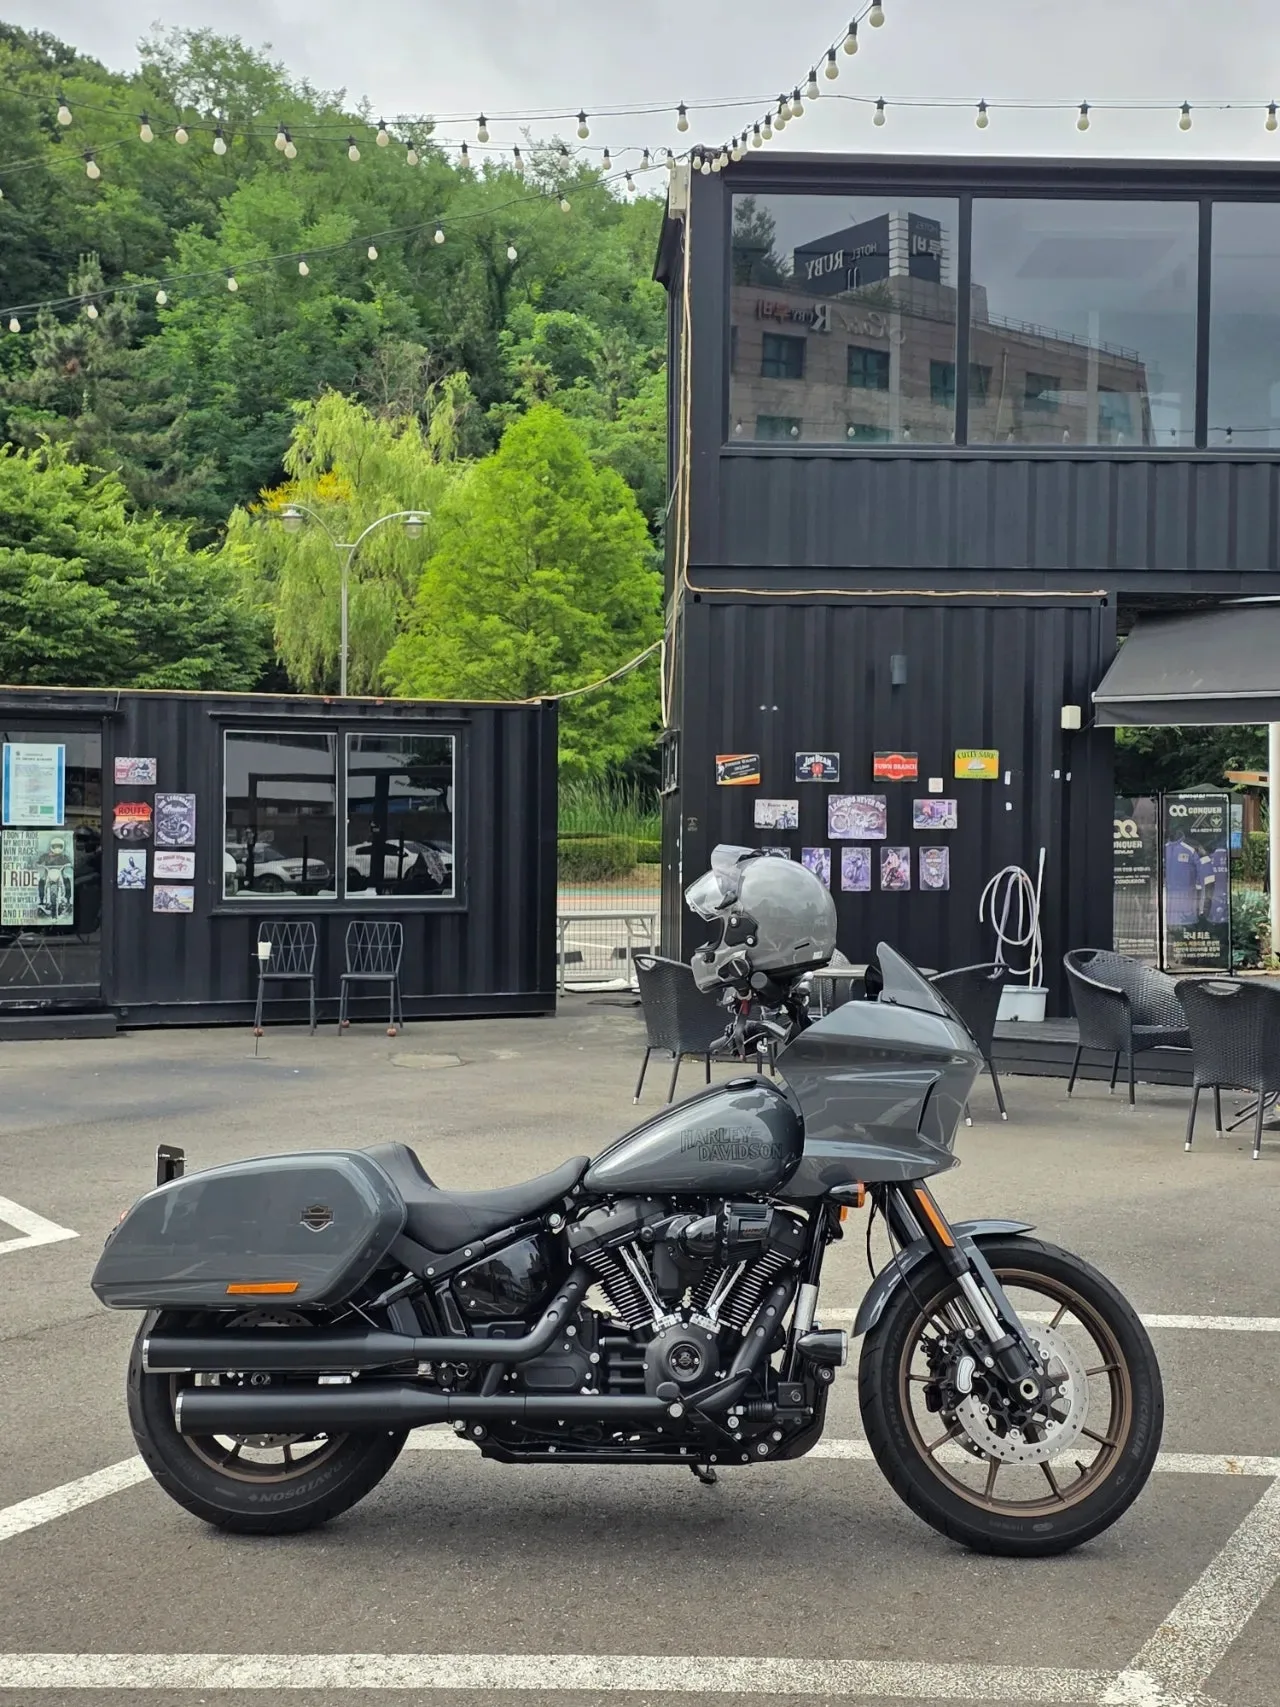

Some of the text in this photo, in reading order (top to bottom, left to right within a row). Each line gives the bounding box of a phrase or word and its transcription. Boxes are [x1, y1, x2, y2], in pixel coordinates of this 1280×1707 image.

[875, 763, 917, 771] TOWN BRANCH
[118, 806, 147, 815] ROUTE
[25, 831, 39, 839] RIDE
[119, 823, 147, 839] 66
[3, 847, 39, 855] WIN RACES
[3, 862, 14, 870] GET
[3, 871, 38, 887] I RIDE
[3, 910, 17, 918] AND
[698, 1143, 783, 1162] DAVIDSON
